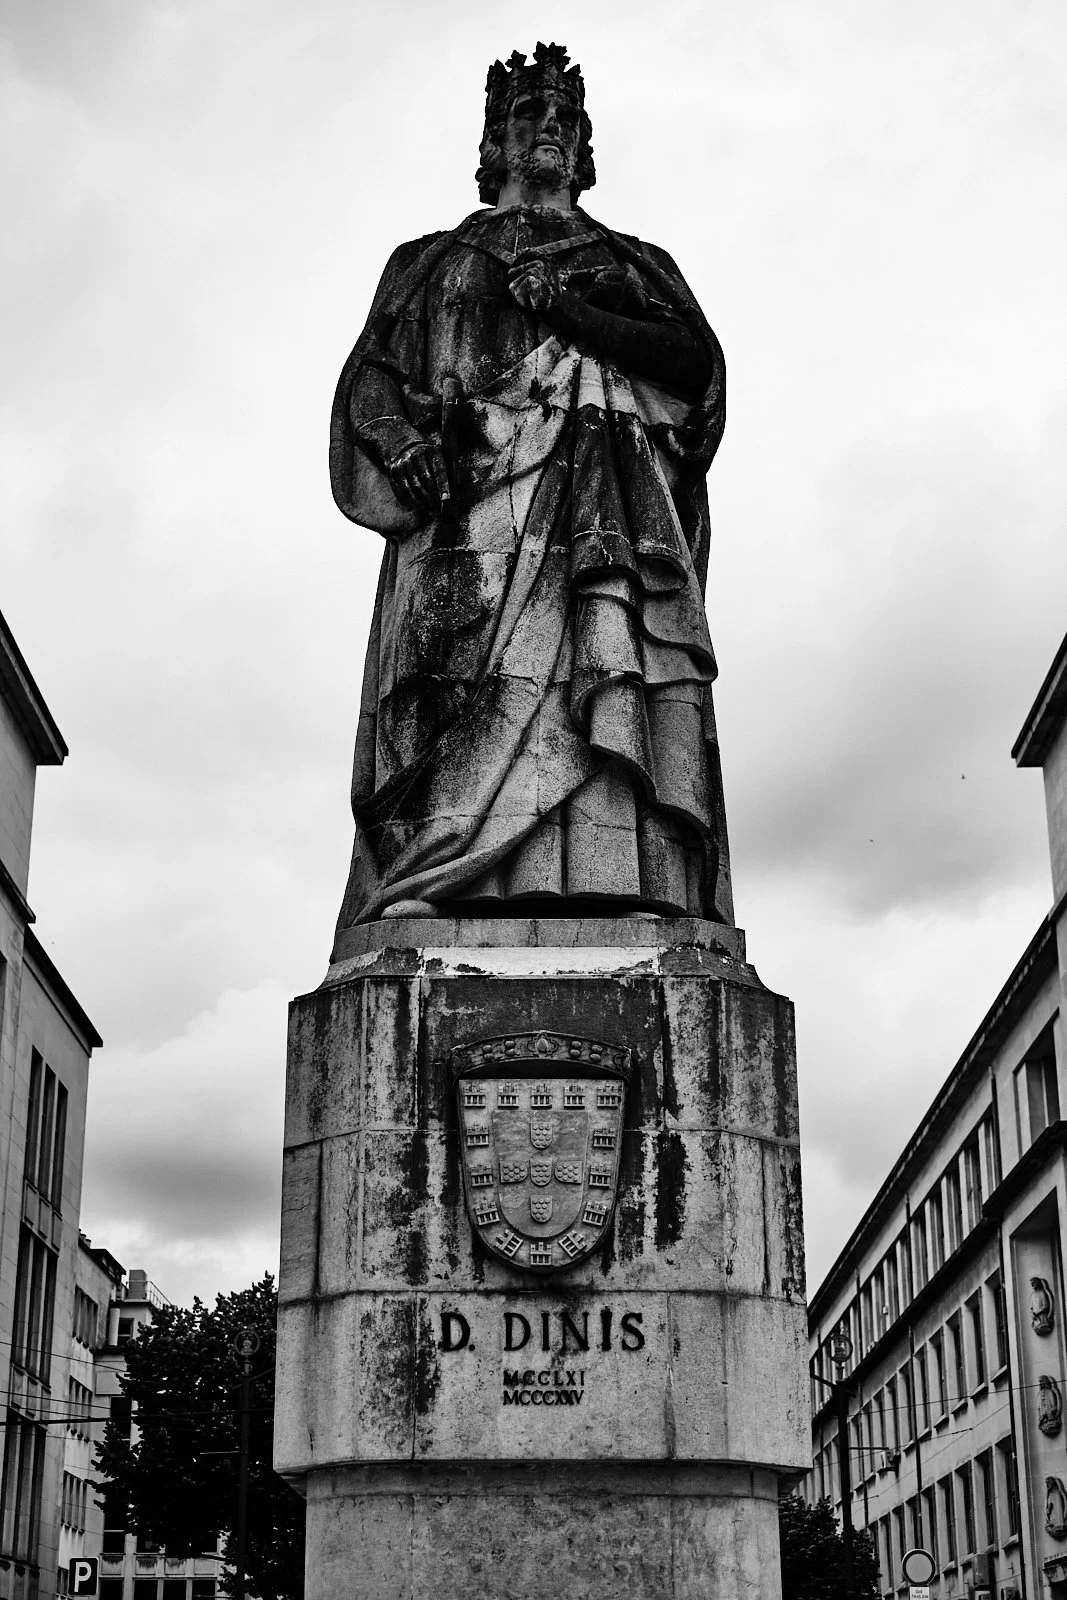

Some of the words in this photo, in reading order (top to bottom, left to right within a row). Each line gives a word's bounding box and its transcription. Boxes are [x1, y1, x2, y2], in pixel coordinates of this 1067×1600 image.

[440, 1312, 476, 1351] D.
[503, 1312, 645, 1351] DINIS
[503, 1370, 585, 1386] MCCLXI
[503, 1390, 584, 1406] MCCCXXV
[74, 1561, 92, 1592] P
